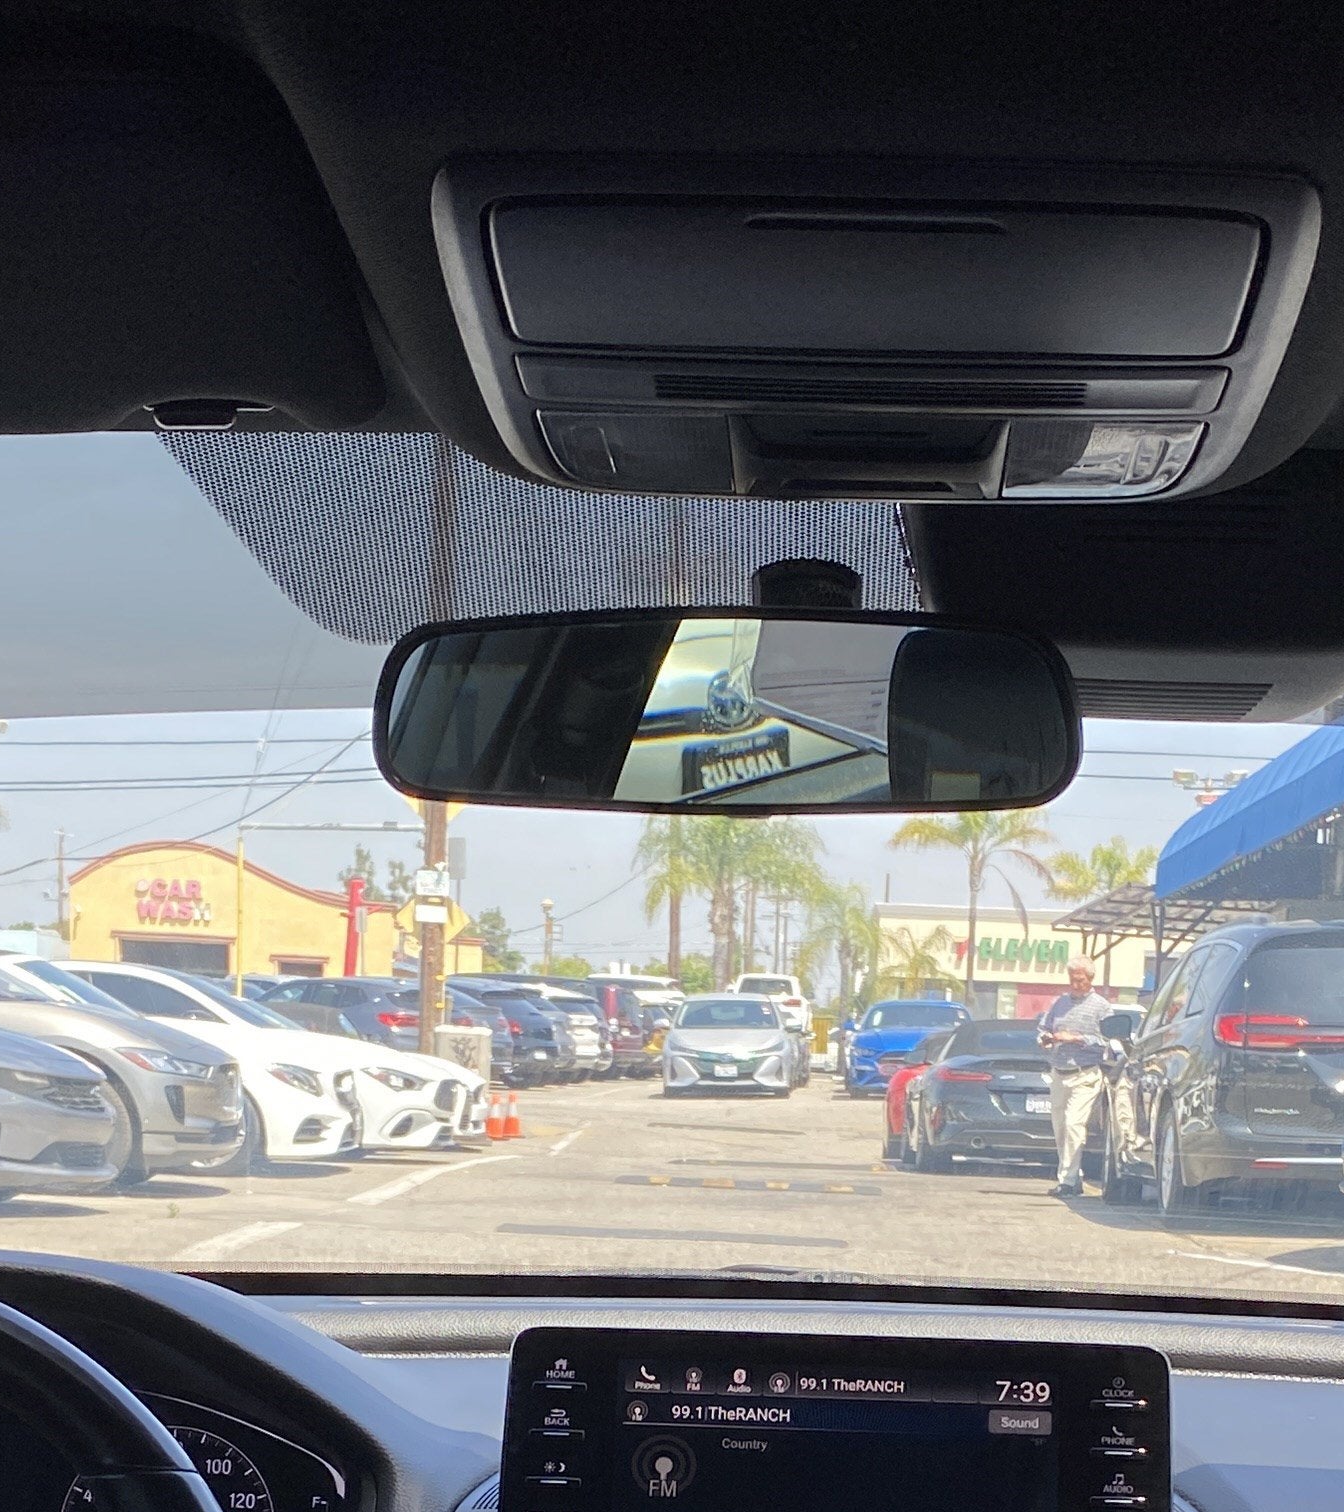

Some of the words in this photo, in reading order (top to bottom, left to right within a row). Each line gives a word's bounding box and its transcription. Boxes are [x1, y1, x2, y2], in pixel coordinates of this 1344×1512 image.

[149, 878, 201, 901] CAR
[137, 900, 211, 923] WASH
[545, 1370, 576, 1380] HOME
[686, 1382, 700, 1391] FM
[727, 1384, 752, 1393] Audio
[800, 1377, 828, 1391] 99.1
[832, 1378, 905, 1394] TheRANCH
[995, 1380, 1051, 1403] 7:39
[1101, 1388, 1135, 1398] CLOCK
[671, 1405, 703, 1420] 99.1
[708, 1406, 791, 1423] TheRANCH
[544, 1416, 570, 1427] BACK
[1001, 1416, 1040, 1429] Sound
[721, 1437, 768, 1451] Country
[1100, 1436, 1136, 1446] PHONE
[205, 1459, 232, 1476] 100
[648, 1479, 677, 1497] FM
[1103, 1484, 1133, 1494] AUDIO
[229, 1493, 256, 1509] 120
[312, 1496, 322, 1508] F
